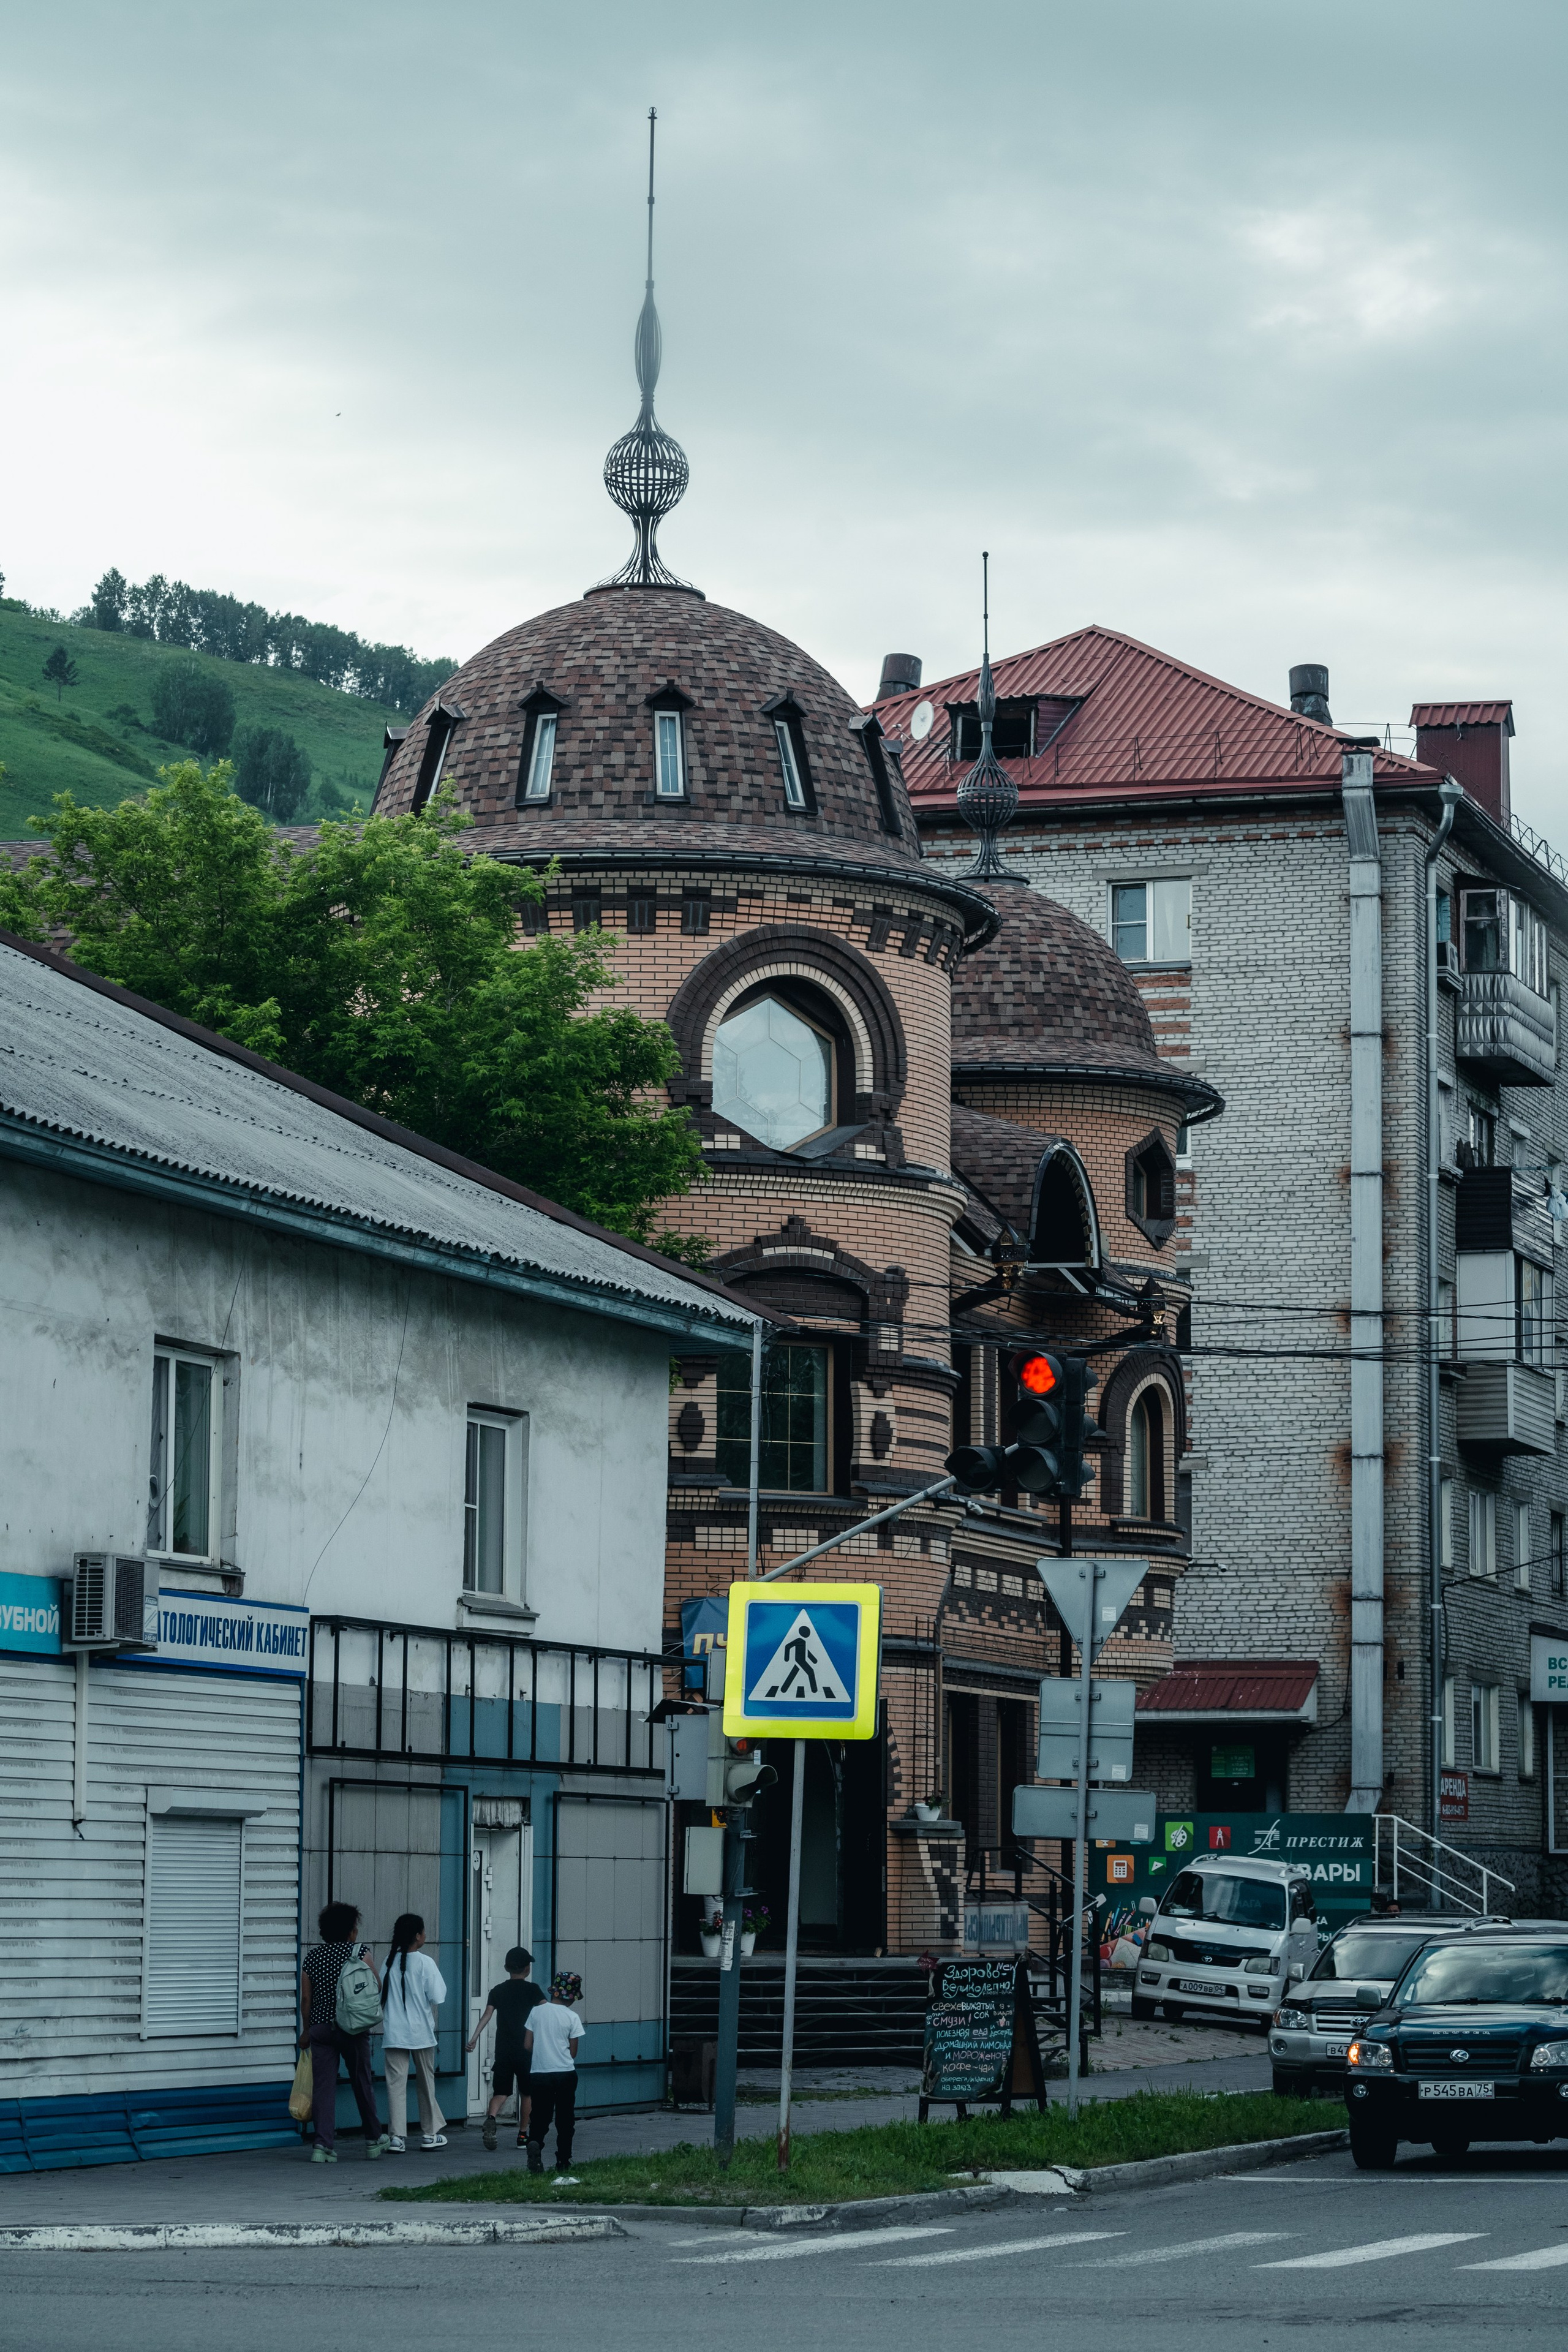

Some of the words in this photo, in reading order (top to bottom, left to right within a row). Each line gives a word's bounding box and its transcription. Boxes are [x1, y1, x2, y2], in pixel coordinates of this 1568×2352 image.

[0, 1604, 59, 1634] УБНОЙ
[256, 1622, 307, 1657] КАБИНЕТ
[1548, 1675, 1568, 1689] РЕ
[1441, 1777, 1466, 1800] АРЕНДА
[1286, 1836, 1365, 1848] ПРЕСТИЖ
[1477, 2084, 1489, 2094] 75
